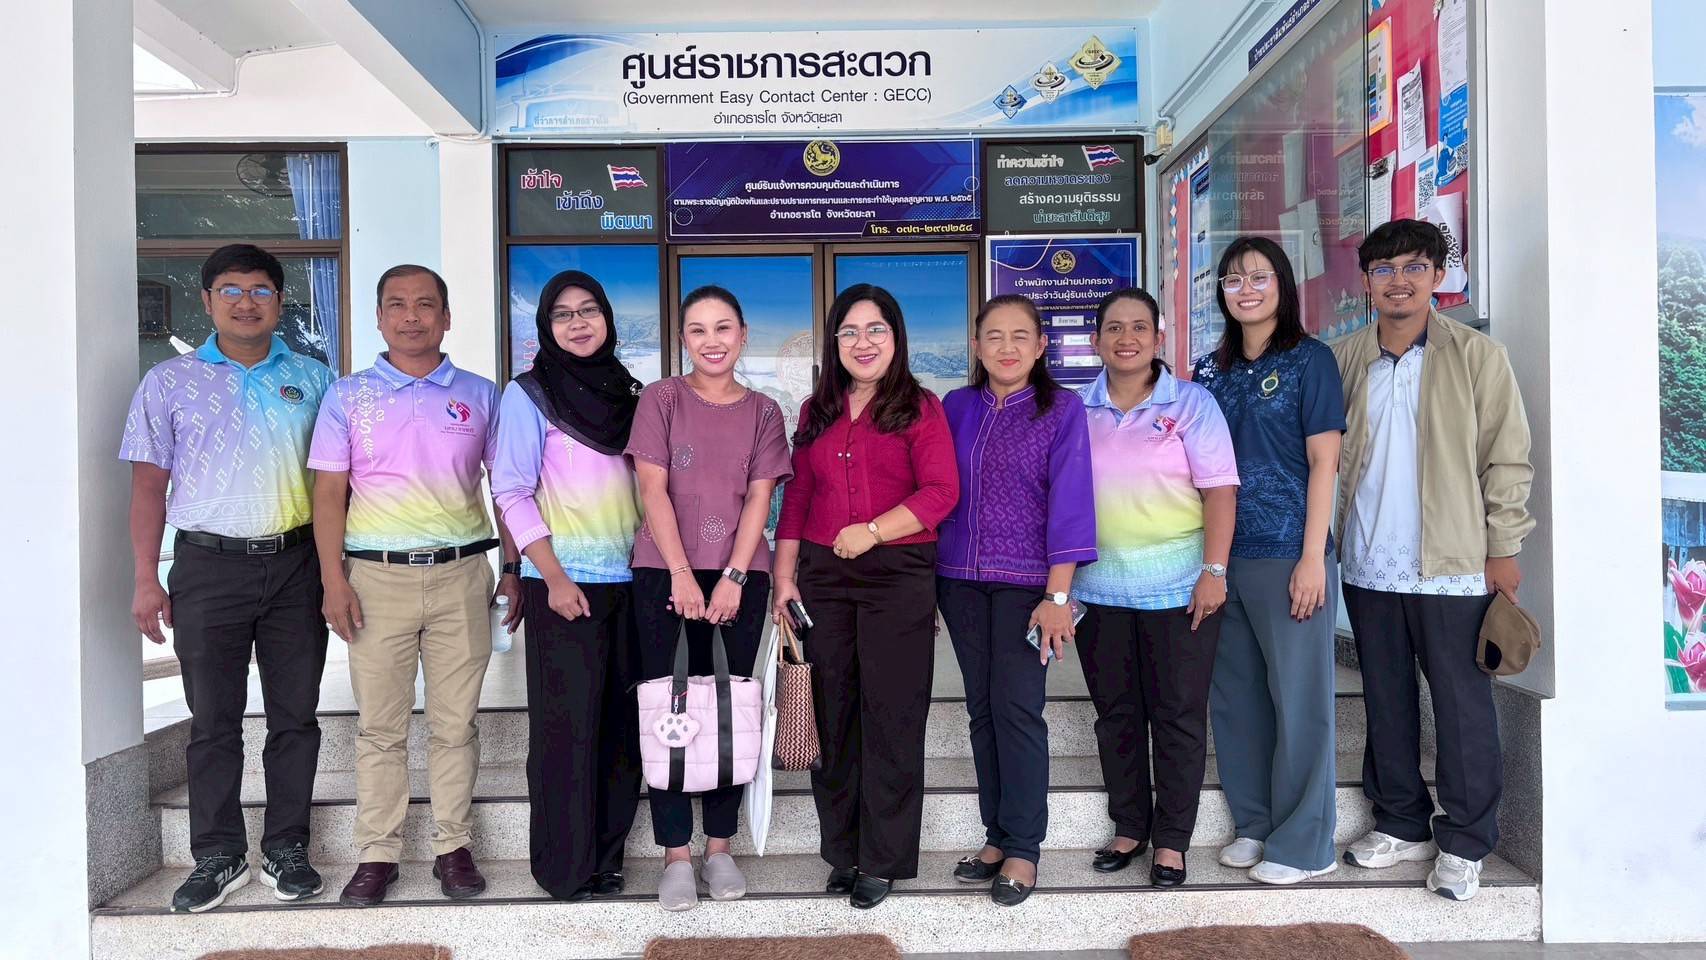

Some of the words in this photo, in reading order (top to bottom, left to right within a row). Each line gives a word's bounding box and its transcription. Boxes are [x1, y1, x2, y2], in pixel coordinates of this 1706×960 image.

[622, 44, 931, 89] ศูนย์ราชการสะดวก
[623, 91, 714, 108] (Government
[720, 90, 753, 107] Easy
[759, 90, 815, 103] Contact
[821, 89, 868, 102] Center
[883, 88, 932, 104] GECC)
[713, 110, 776, 125] อำเภอธารโต
[781, 111, 843, 124] จังหวัดยะลา
[997, 154, 1065, 168] ทำความเข้าใจ
[521, 168, 563, 189] เข้าใจ
[745, 179, 900, 193] ศูนย์รับแจ้งการควบคุมตัวและดำเนินการ
[556, 189, 604, 211] เข้าถึง
[934, 195, 949, 203] พ.ศ.
[1019, 191, 1121, 207] สร้างความยุติธรรม
[600, 210, 653, 230] พัฒนา
[770, 209, 822, 220] อำเภอธารโต
[827, 209, 876, 219] จังหวัดยะลา
[871, 224, 891, 234] โทร.
[1014, 277, 1114, 287] เจ้าพนักงานฝ่ายปกครอง
